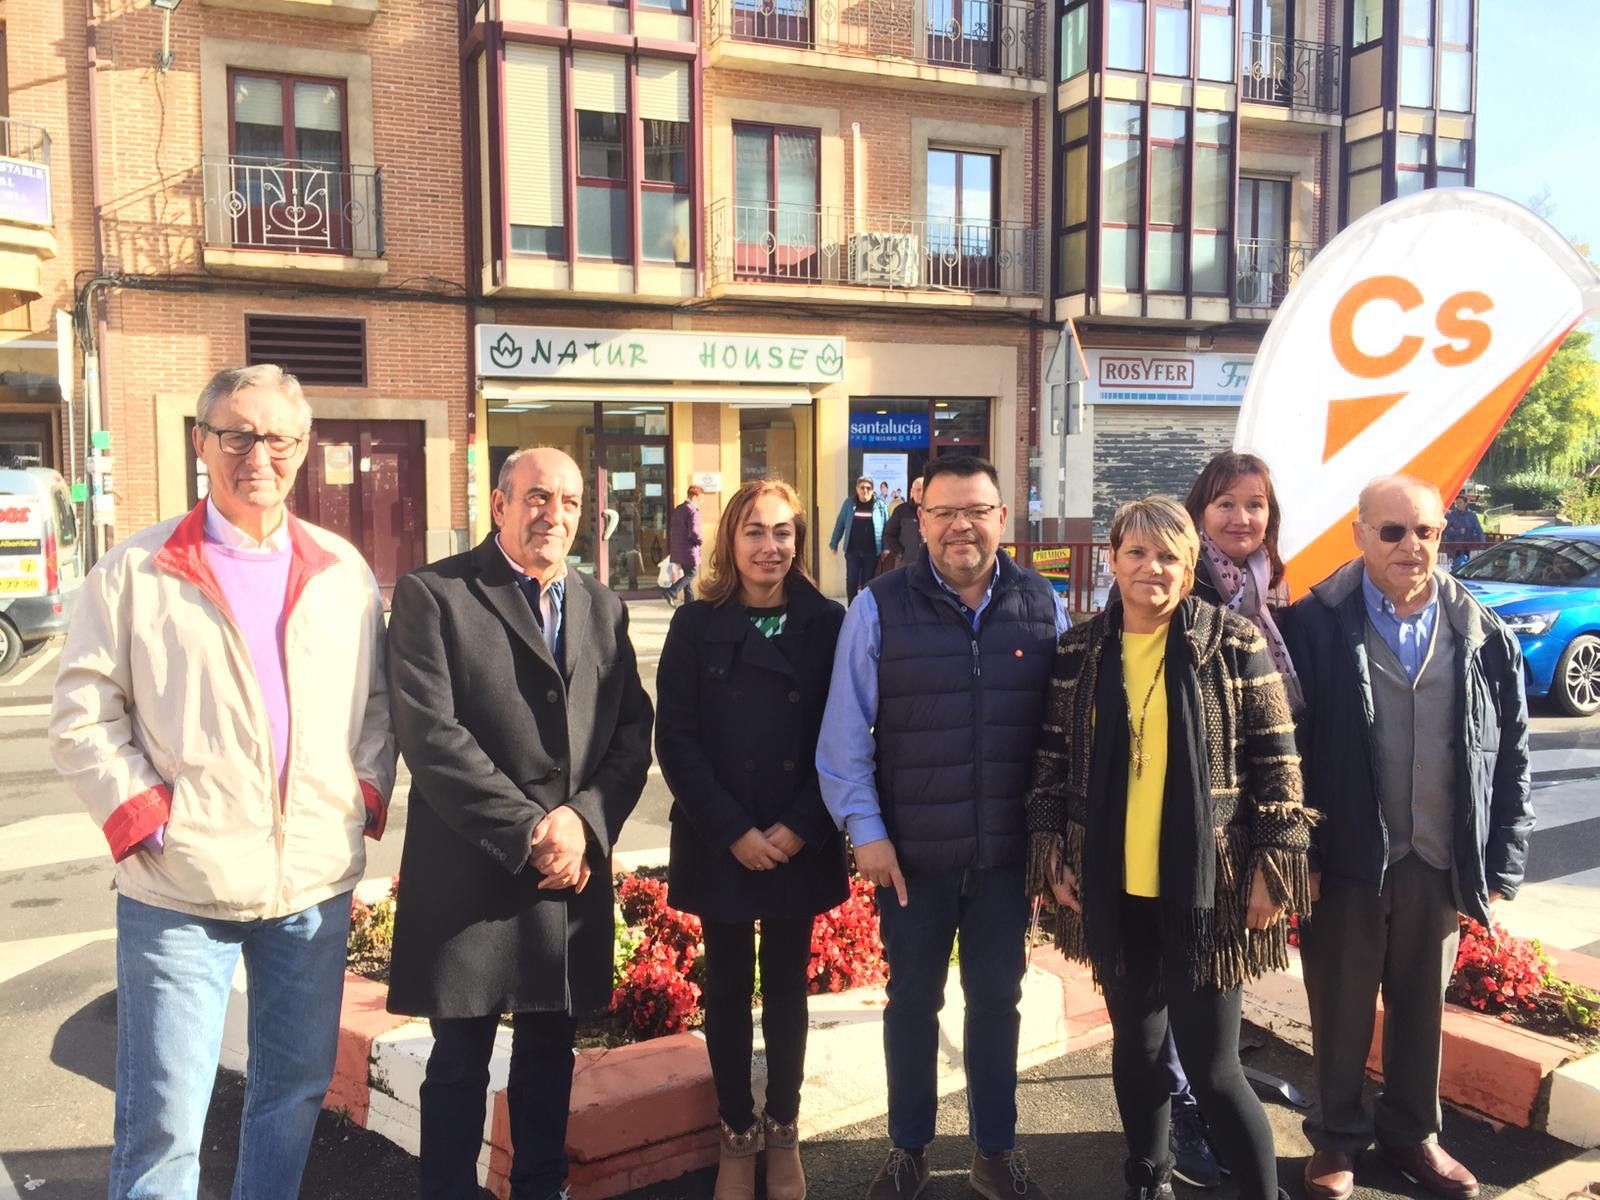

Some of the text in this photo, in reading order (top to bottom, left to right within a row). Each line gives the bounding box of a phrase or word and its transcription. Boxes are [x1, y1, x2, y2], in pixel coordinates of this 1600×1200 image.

[1330, 275, 1495, 379] Cs
[531, 339, 808, 370] NATUR HOUSE
[850, 418, 922, 434] santalucía
